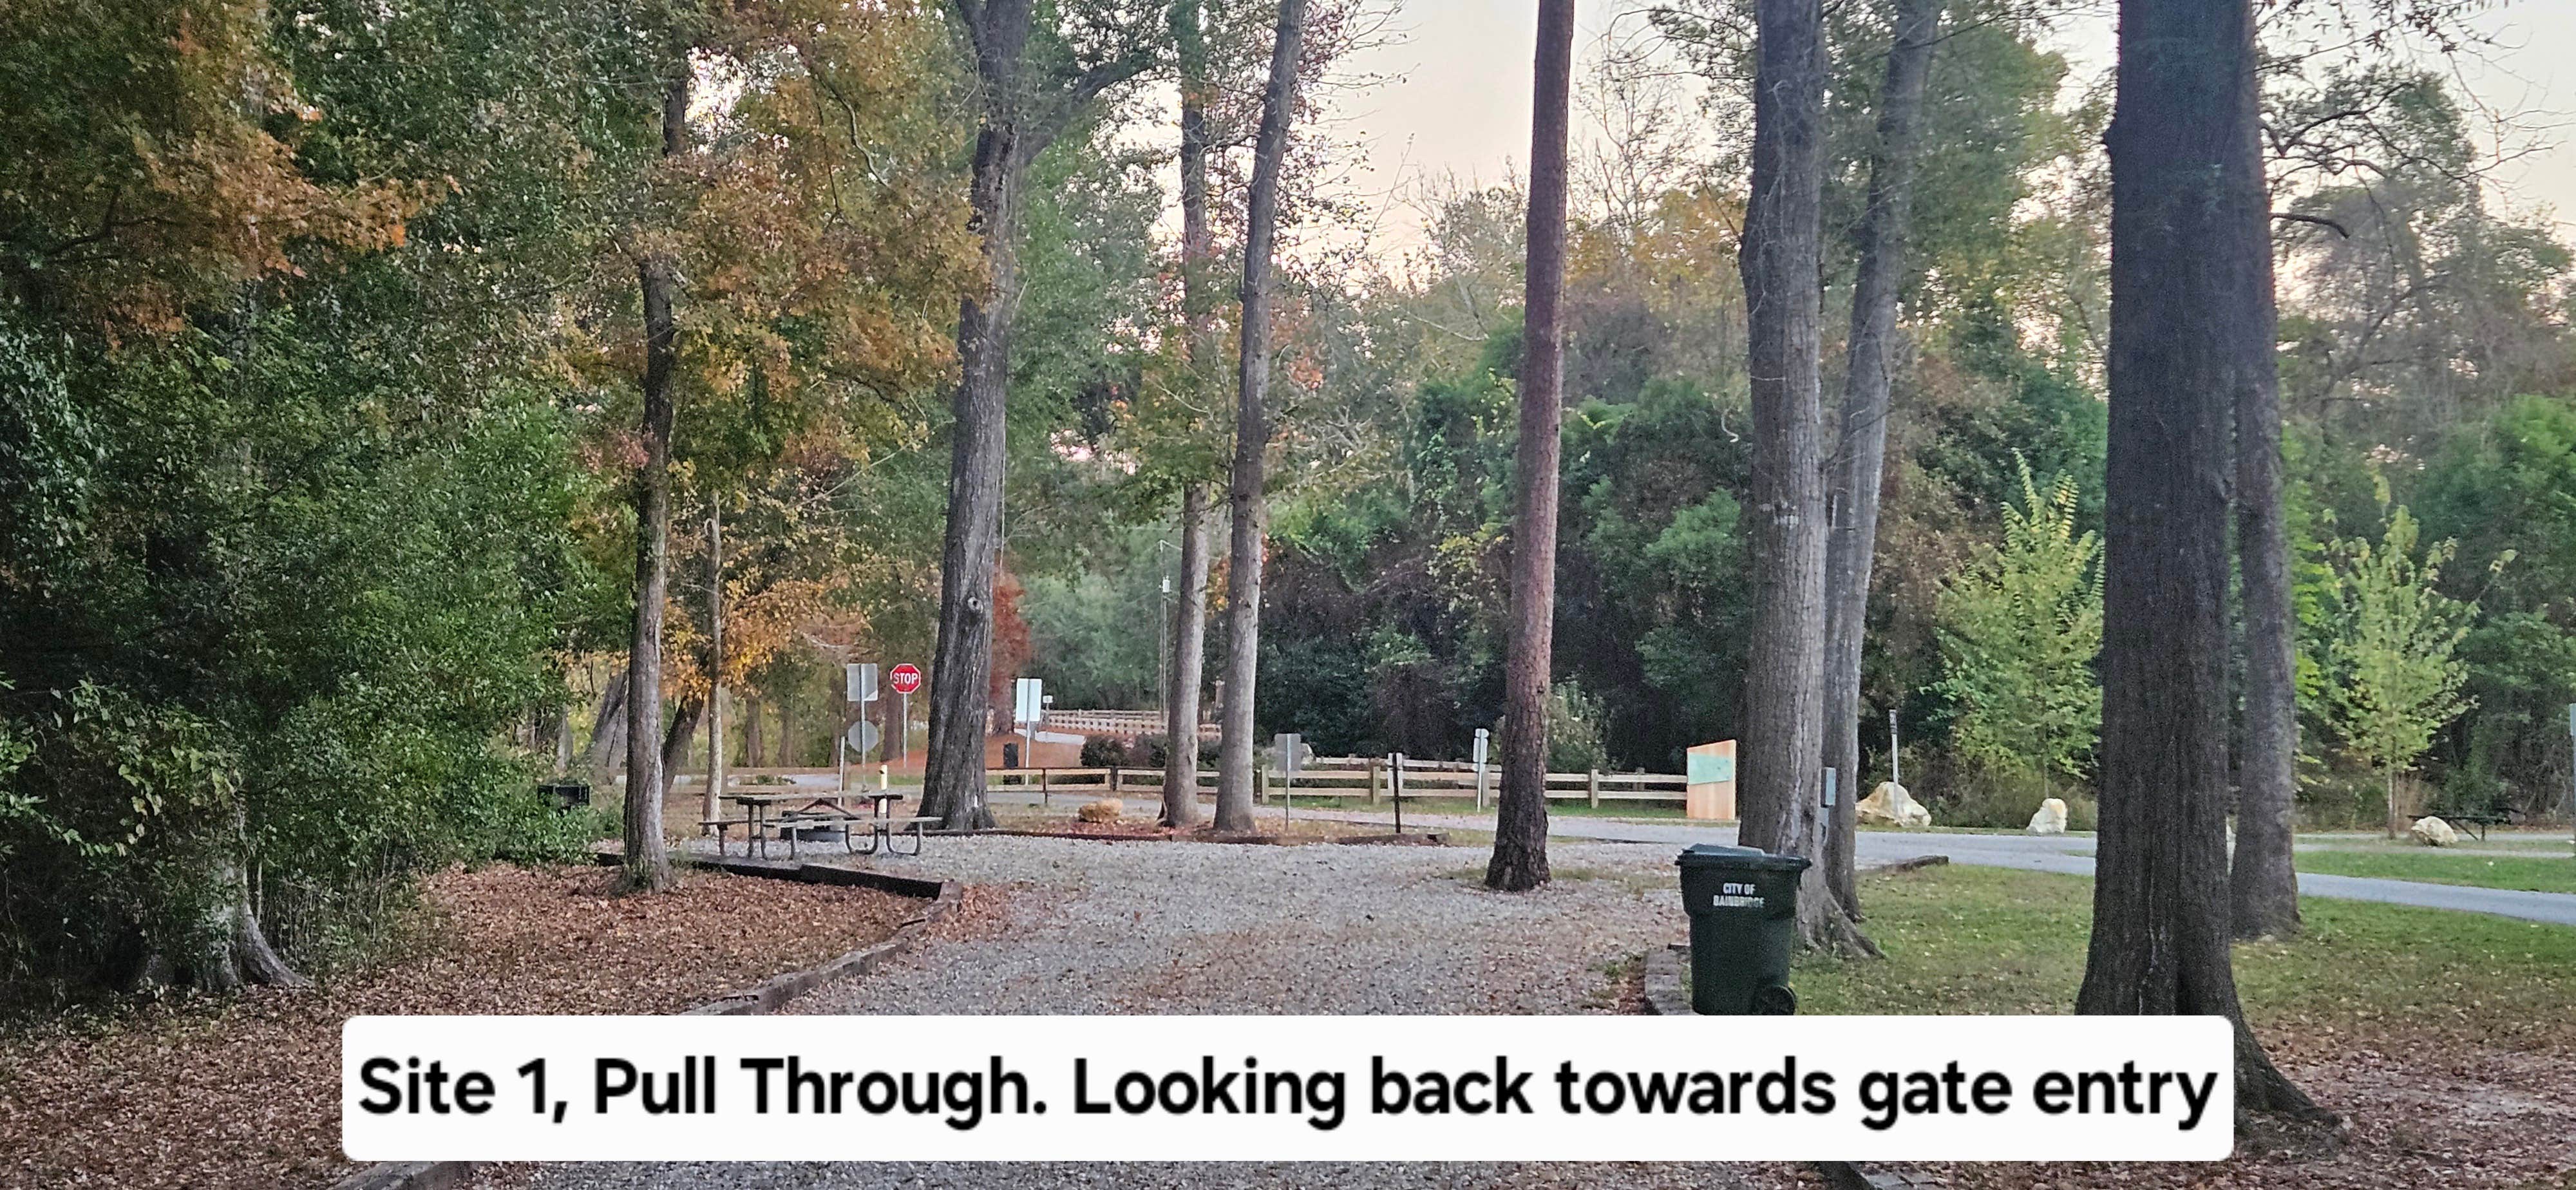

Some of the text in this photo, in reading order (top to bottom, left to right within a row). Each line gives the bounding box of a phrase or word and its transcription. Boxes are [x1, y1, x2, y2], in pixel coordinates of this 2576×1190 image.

[893, 673, 918, 685] STOP
[1723, 883, 1756, 894] CITY OF
